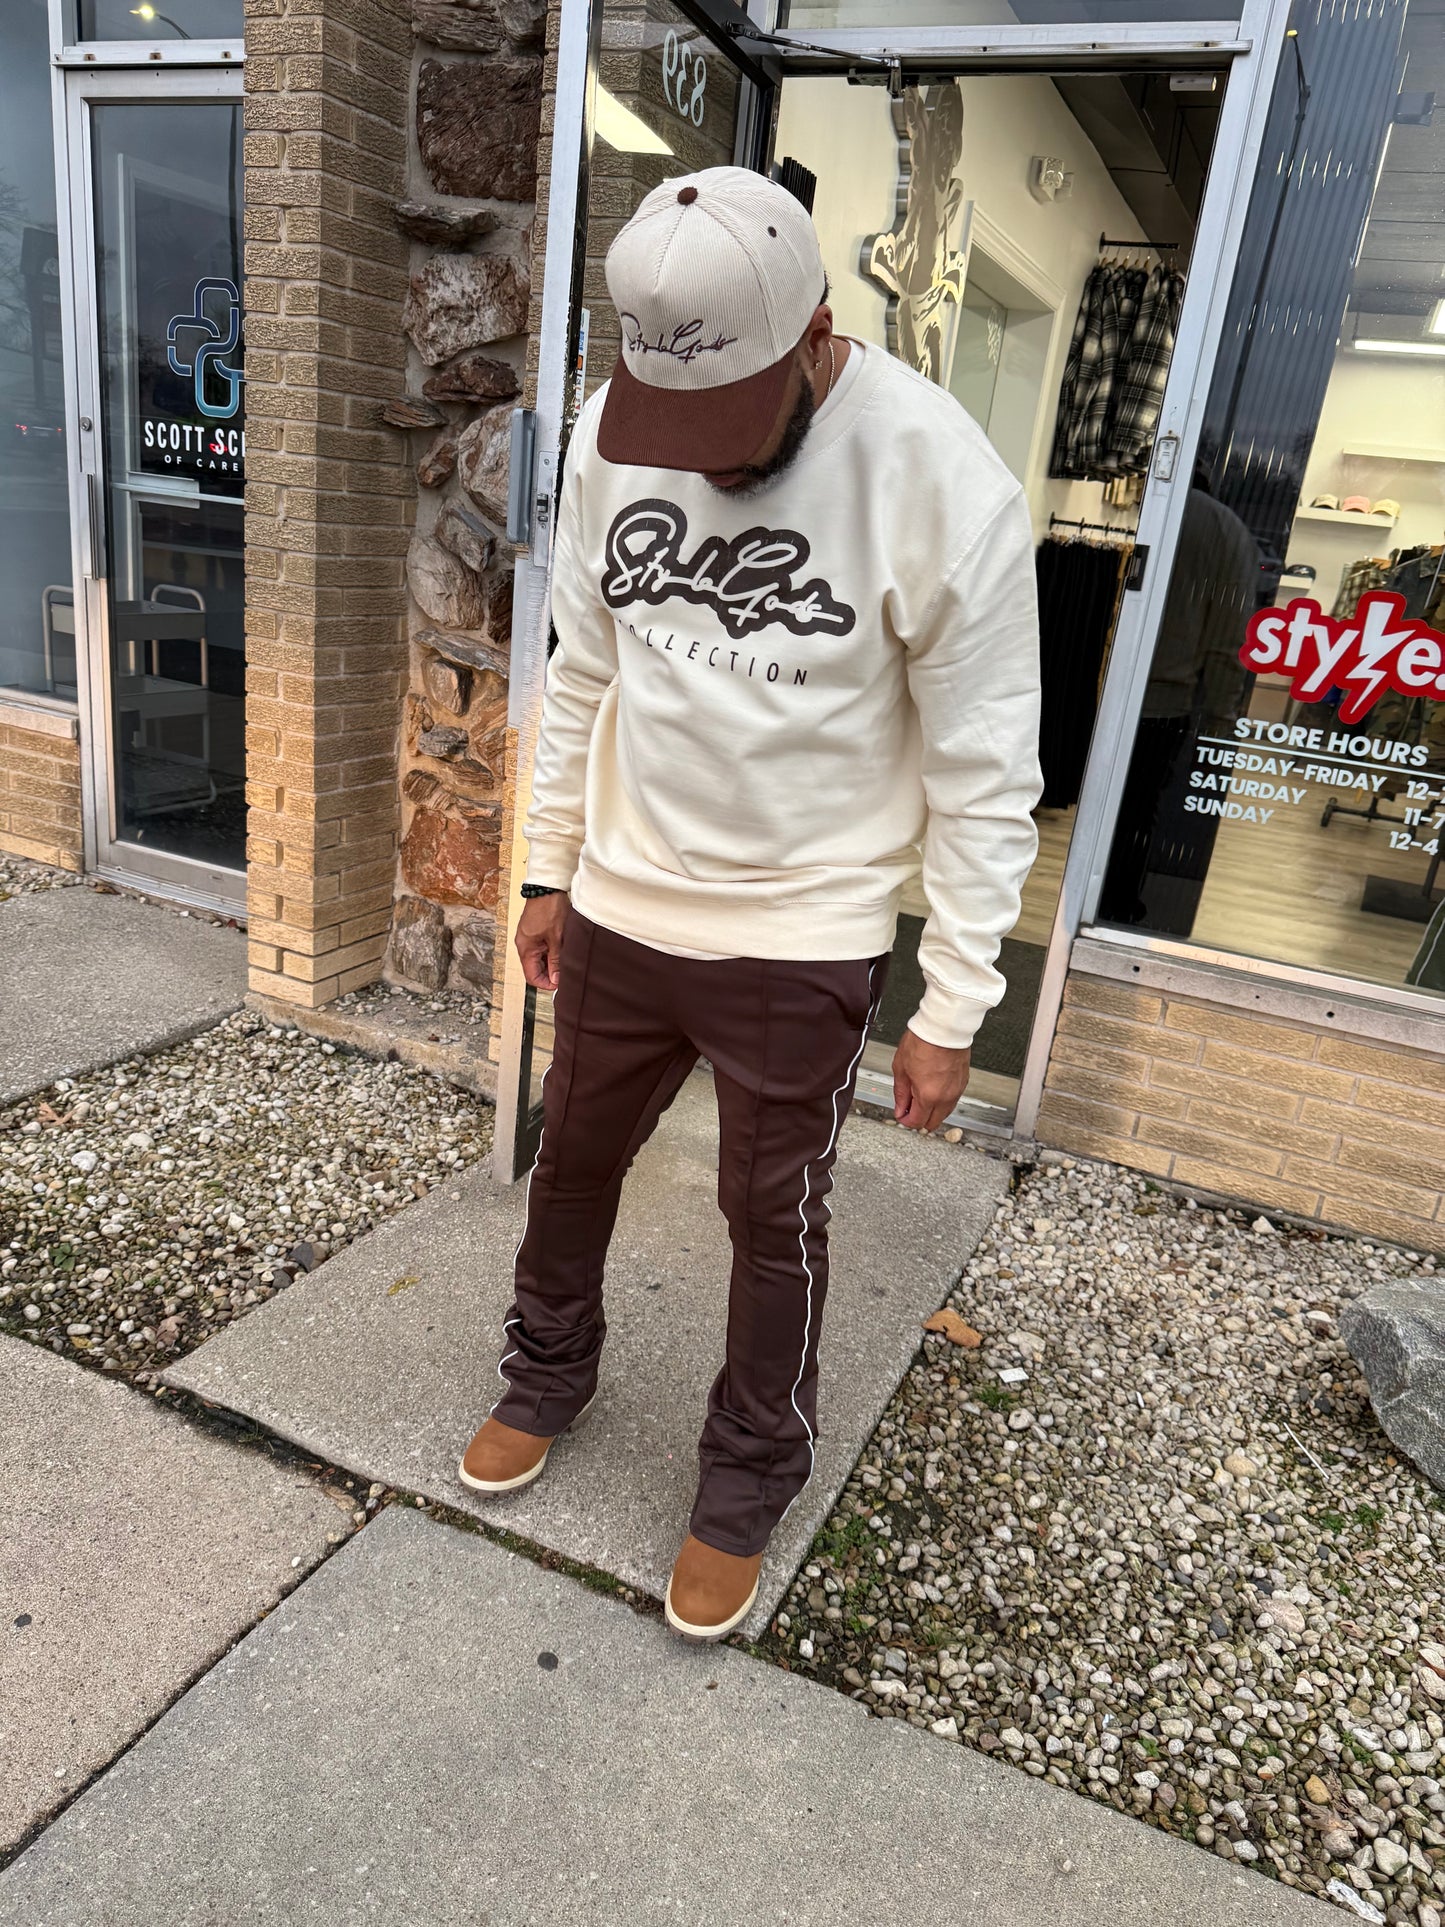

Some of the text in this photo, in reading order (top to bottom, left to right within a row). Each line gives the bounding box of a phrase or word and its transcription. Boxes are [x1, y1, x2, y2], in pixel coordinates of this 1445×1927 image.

[144, 420, 205, 453] SCOTT
[164, 454, 239, 472] OF CARE
[618, 618, 808, 686] OLLECTION
[1233, 717, 1430, 767] STORE HOURS
[1196, 745, 1388, 793] TUESDAY-FRIDAY
[1189, 770, 1445, 830] SATURDAY 11-7
[1183, 795, 1440, 856] SUNDAY 12-4
